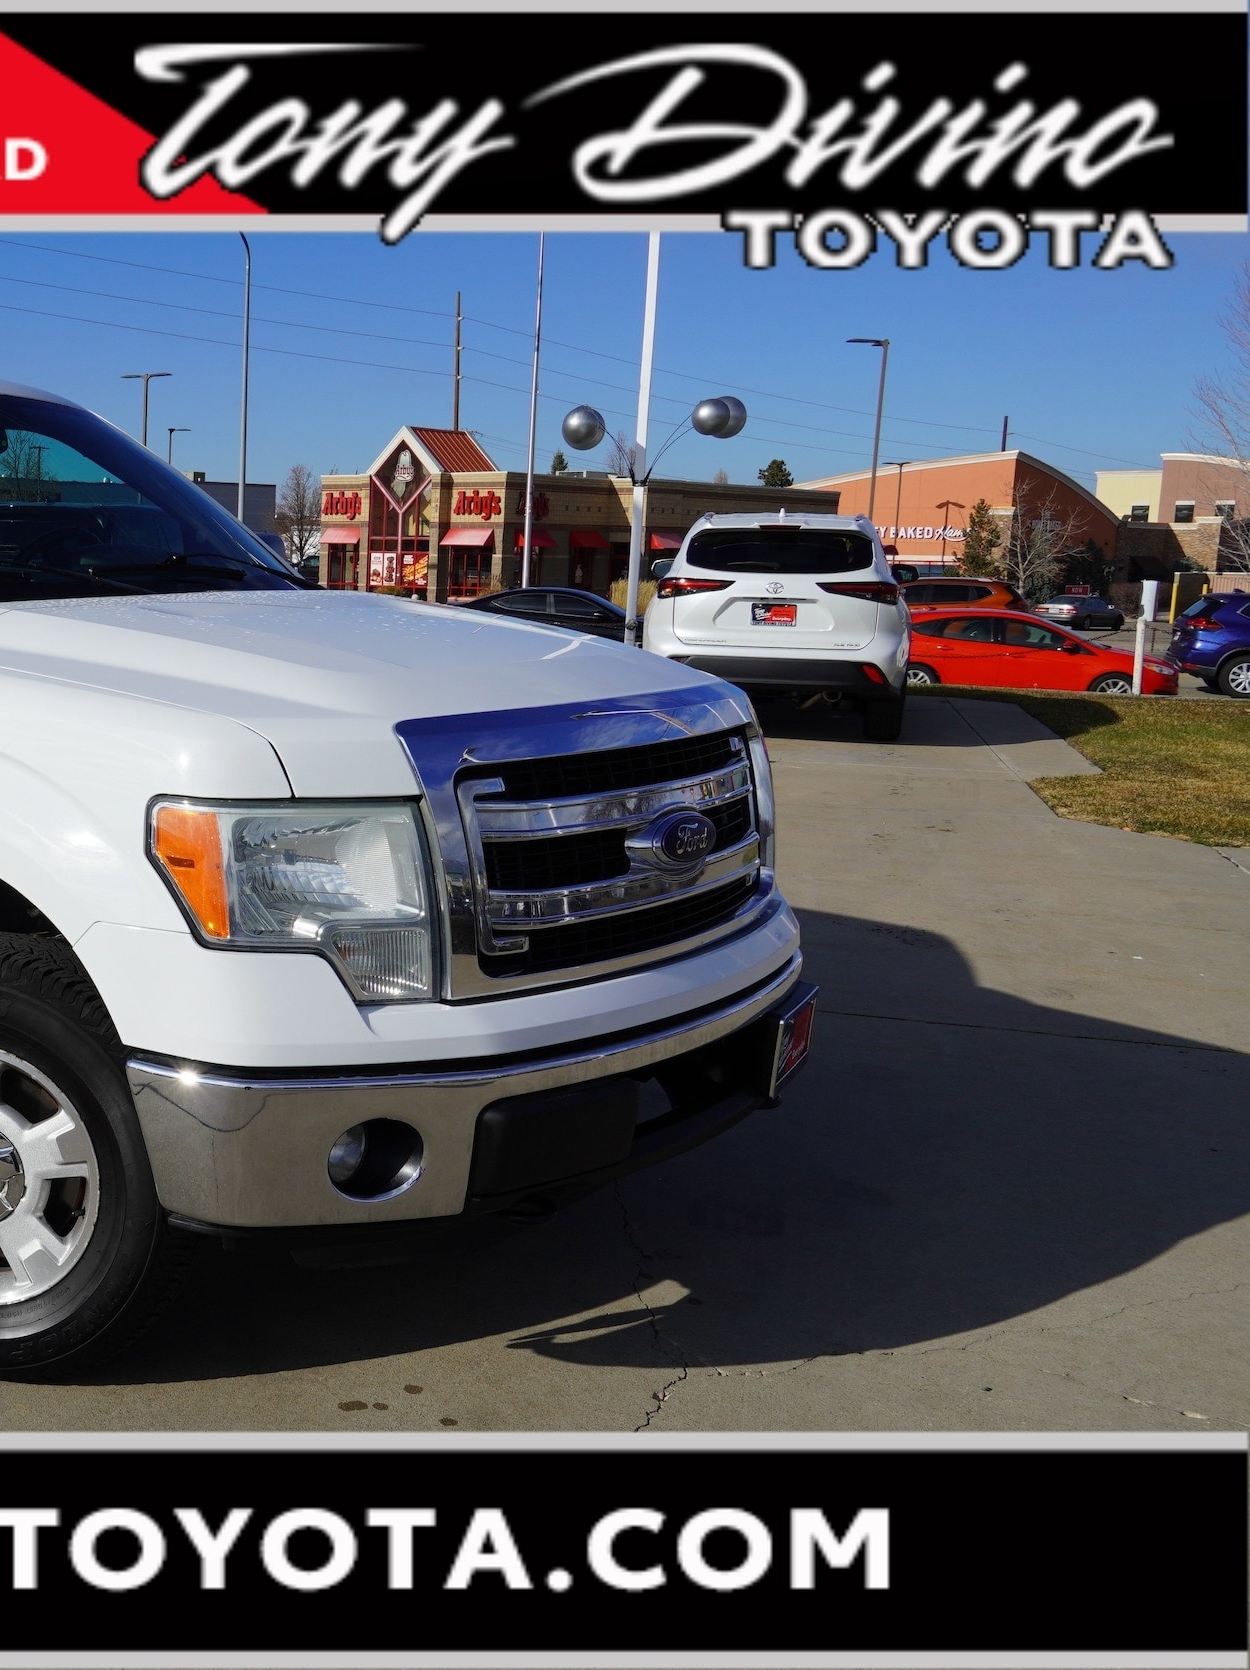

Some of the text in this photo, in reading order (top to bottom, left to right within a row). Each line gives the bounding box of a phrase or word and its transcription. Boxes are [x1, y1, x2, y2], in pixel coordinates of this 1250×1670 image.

[321, 491, 362, 520] Arby's
[453, 489, 502, 521] Arby's
[890, 526, 933, 539] BAKED
[676, 822, 709, 855] Ford
